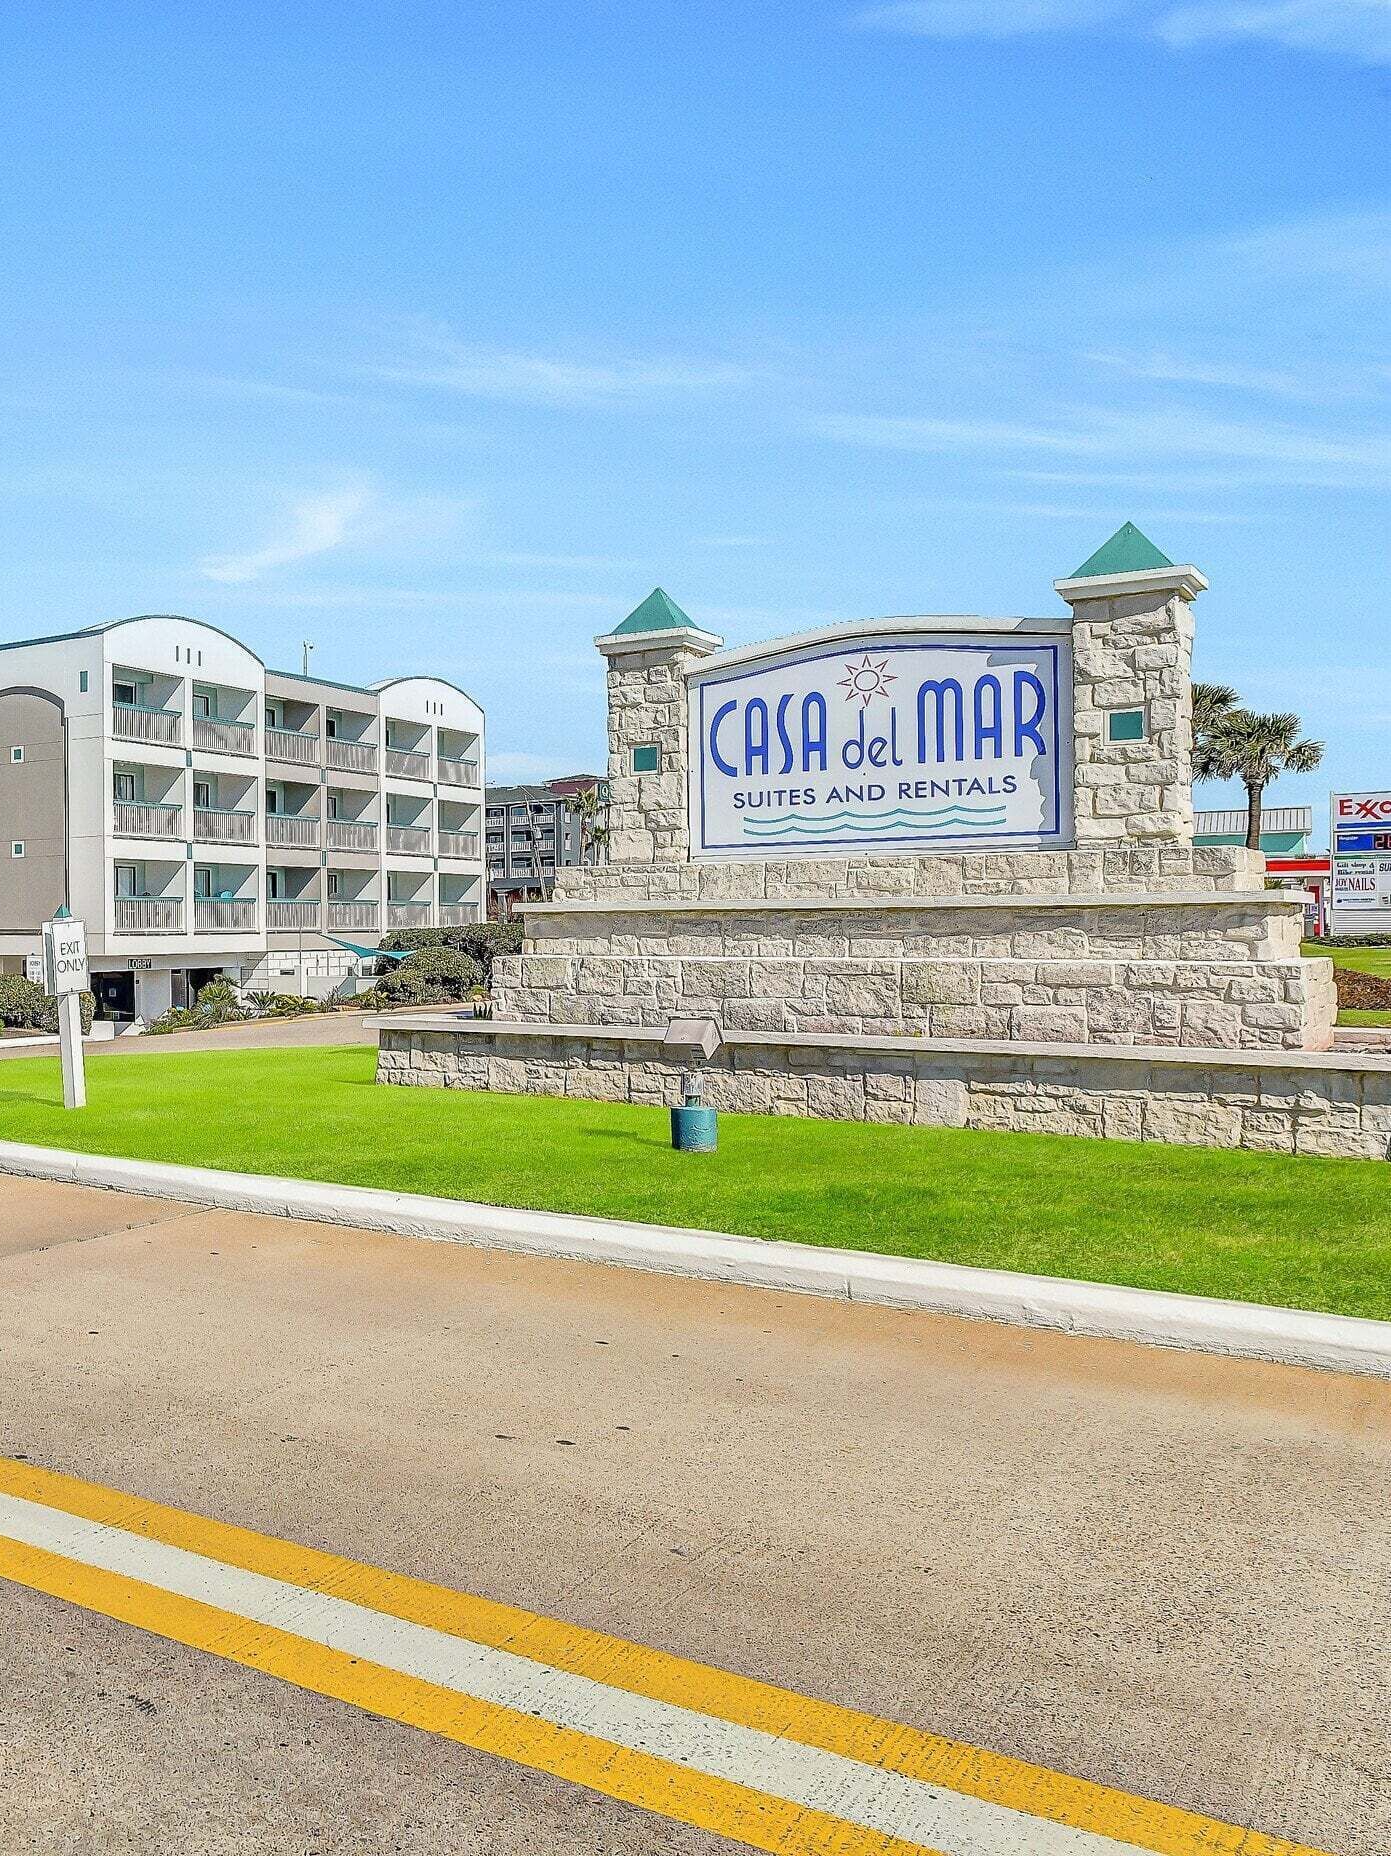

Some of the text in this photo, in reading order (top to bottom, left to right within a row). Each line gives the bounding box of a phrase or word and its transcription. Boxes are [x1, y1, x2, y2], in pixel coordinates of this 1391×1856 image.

[710, 671, 1047, 777] CASA del MAR
[733, 775, 1018, 809] SUITES AND RENTALS
[1348, 877, 1376, 891] NAILS
[61, 941, 80, 955] EXIT
[57, 957, 85, 973] ONLY
[128, 959, 151, 969] LOBBY
